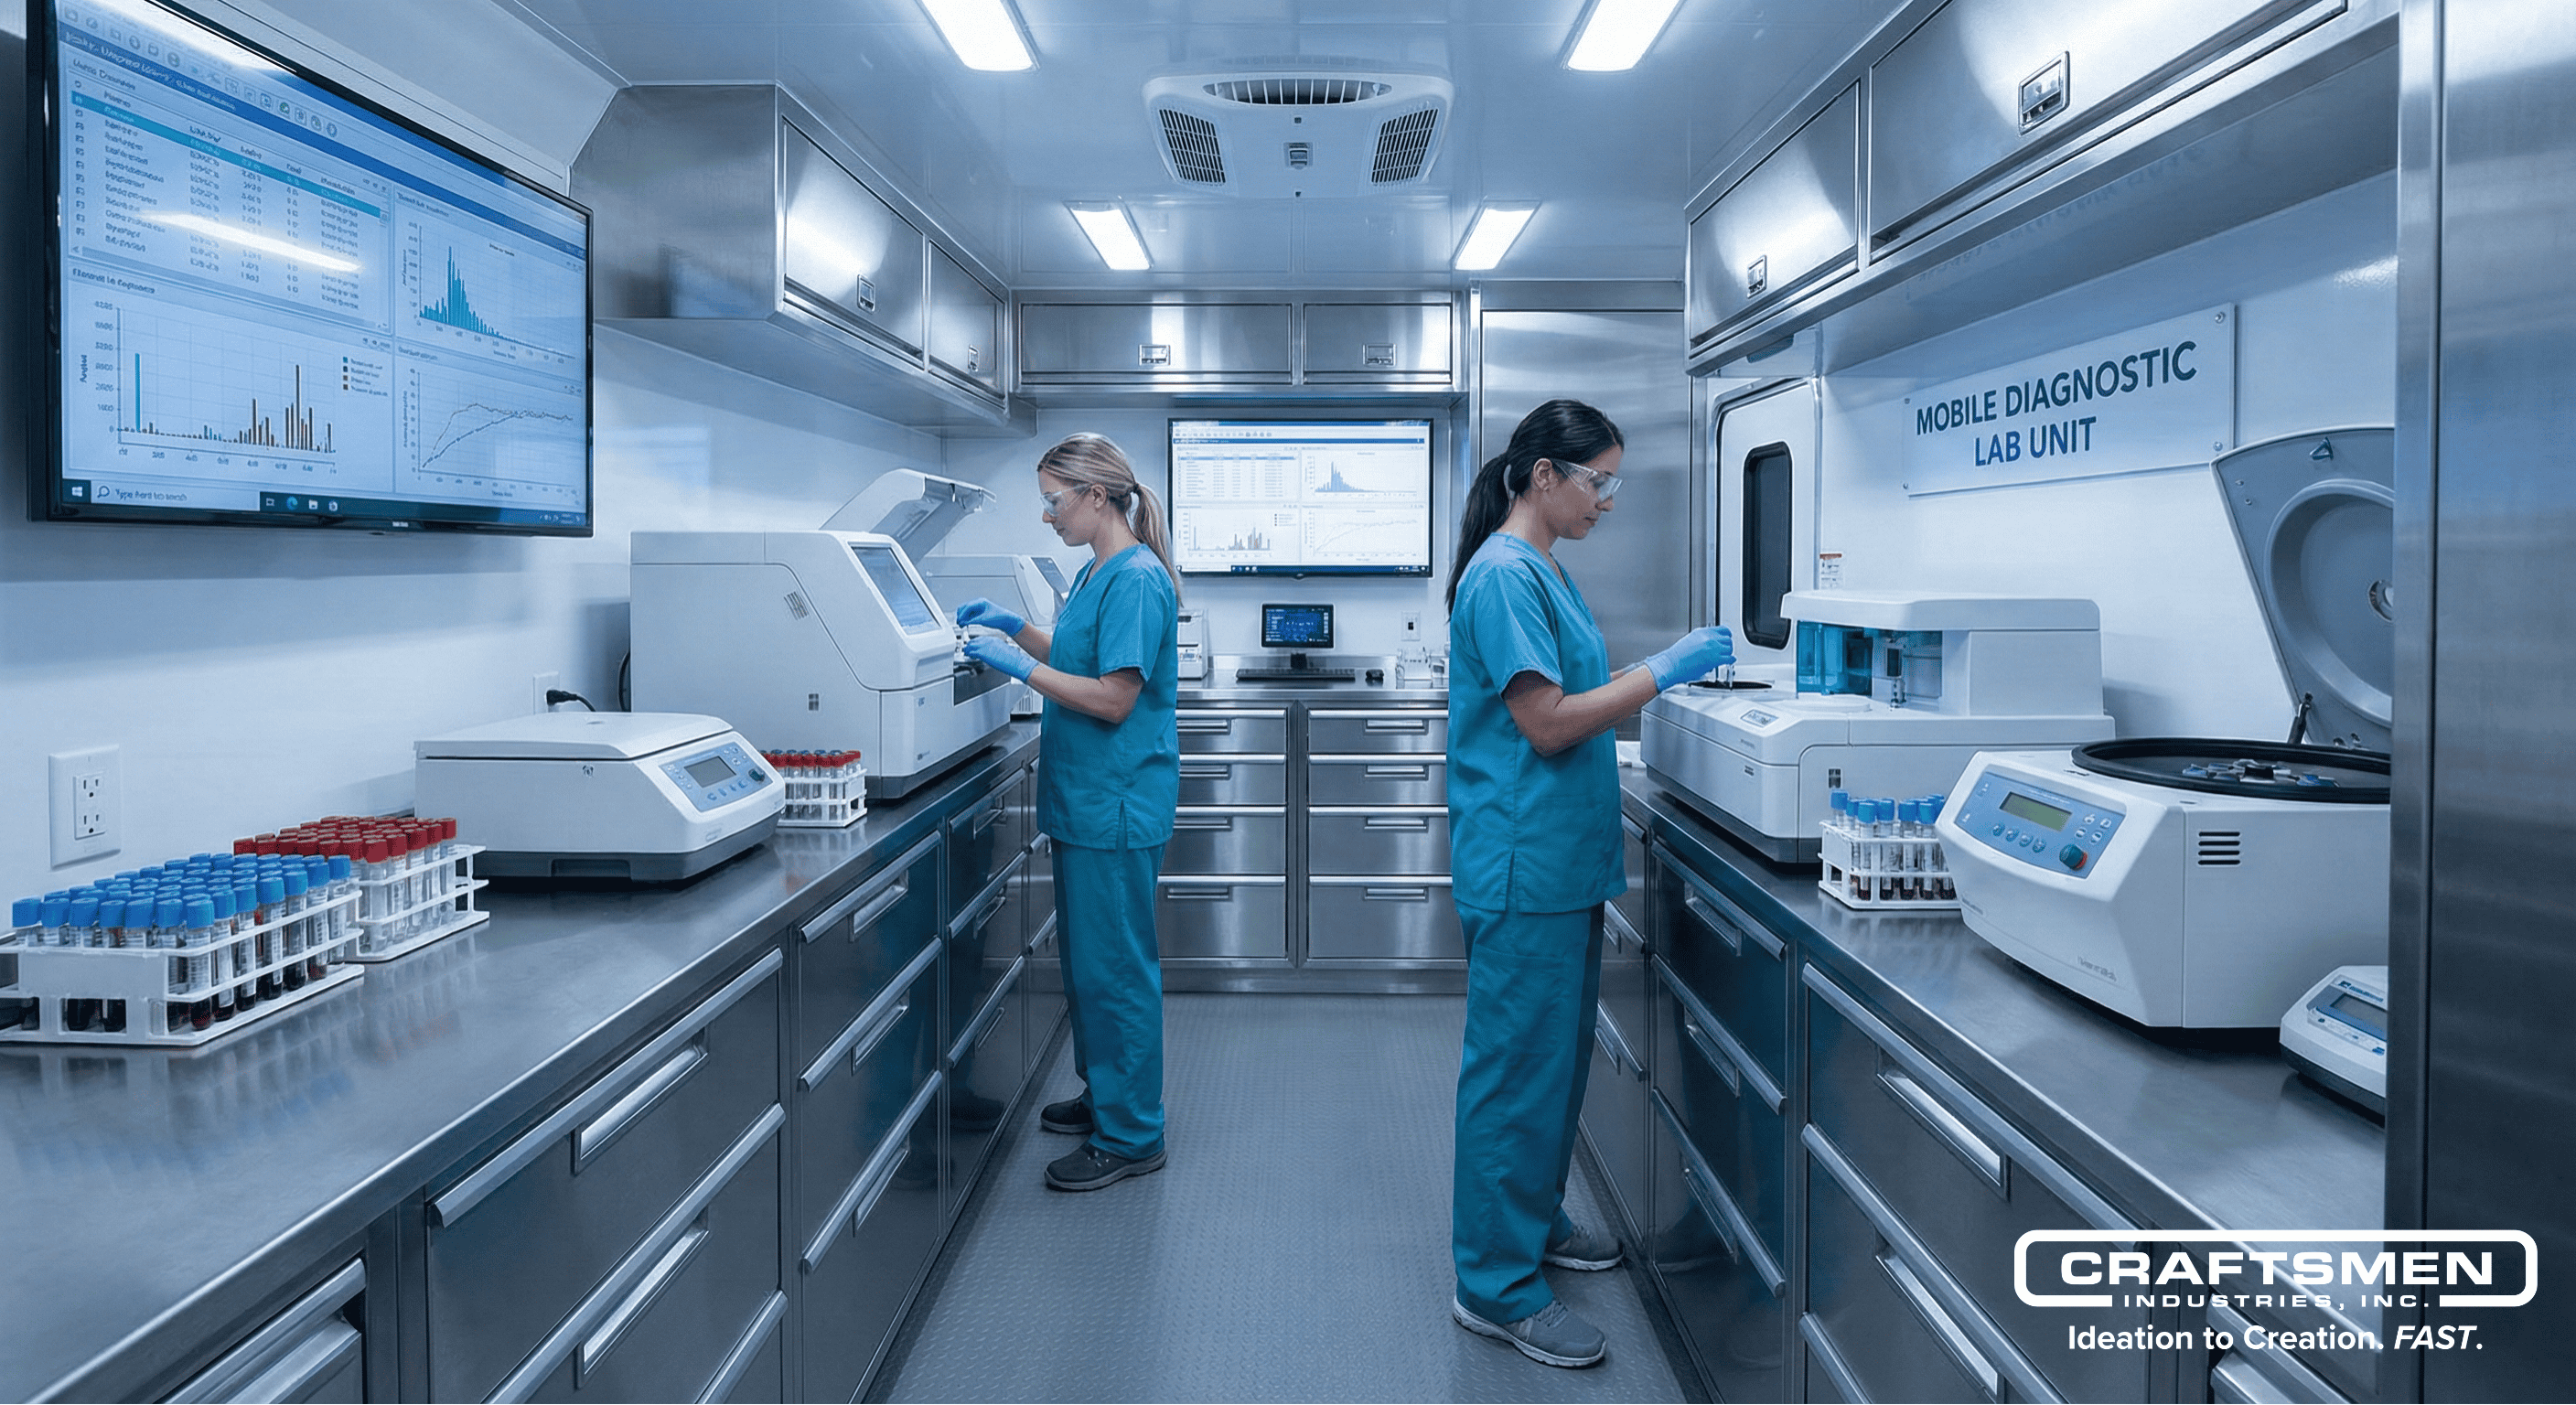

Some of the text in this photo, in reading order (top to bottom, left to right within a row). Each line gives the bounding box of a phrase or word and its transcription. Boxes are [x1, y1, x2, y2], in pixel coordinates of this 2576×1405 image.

[1916, 340, 2197, 435] MOBILE DIAGNOSTIC
[1974, 416, 2097, 467] LAB UNIT
